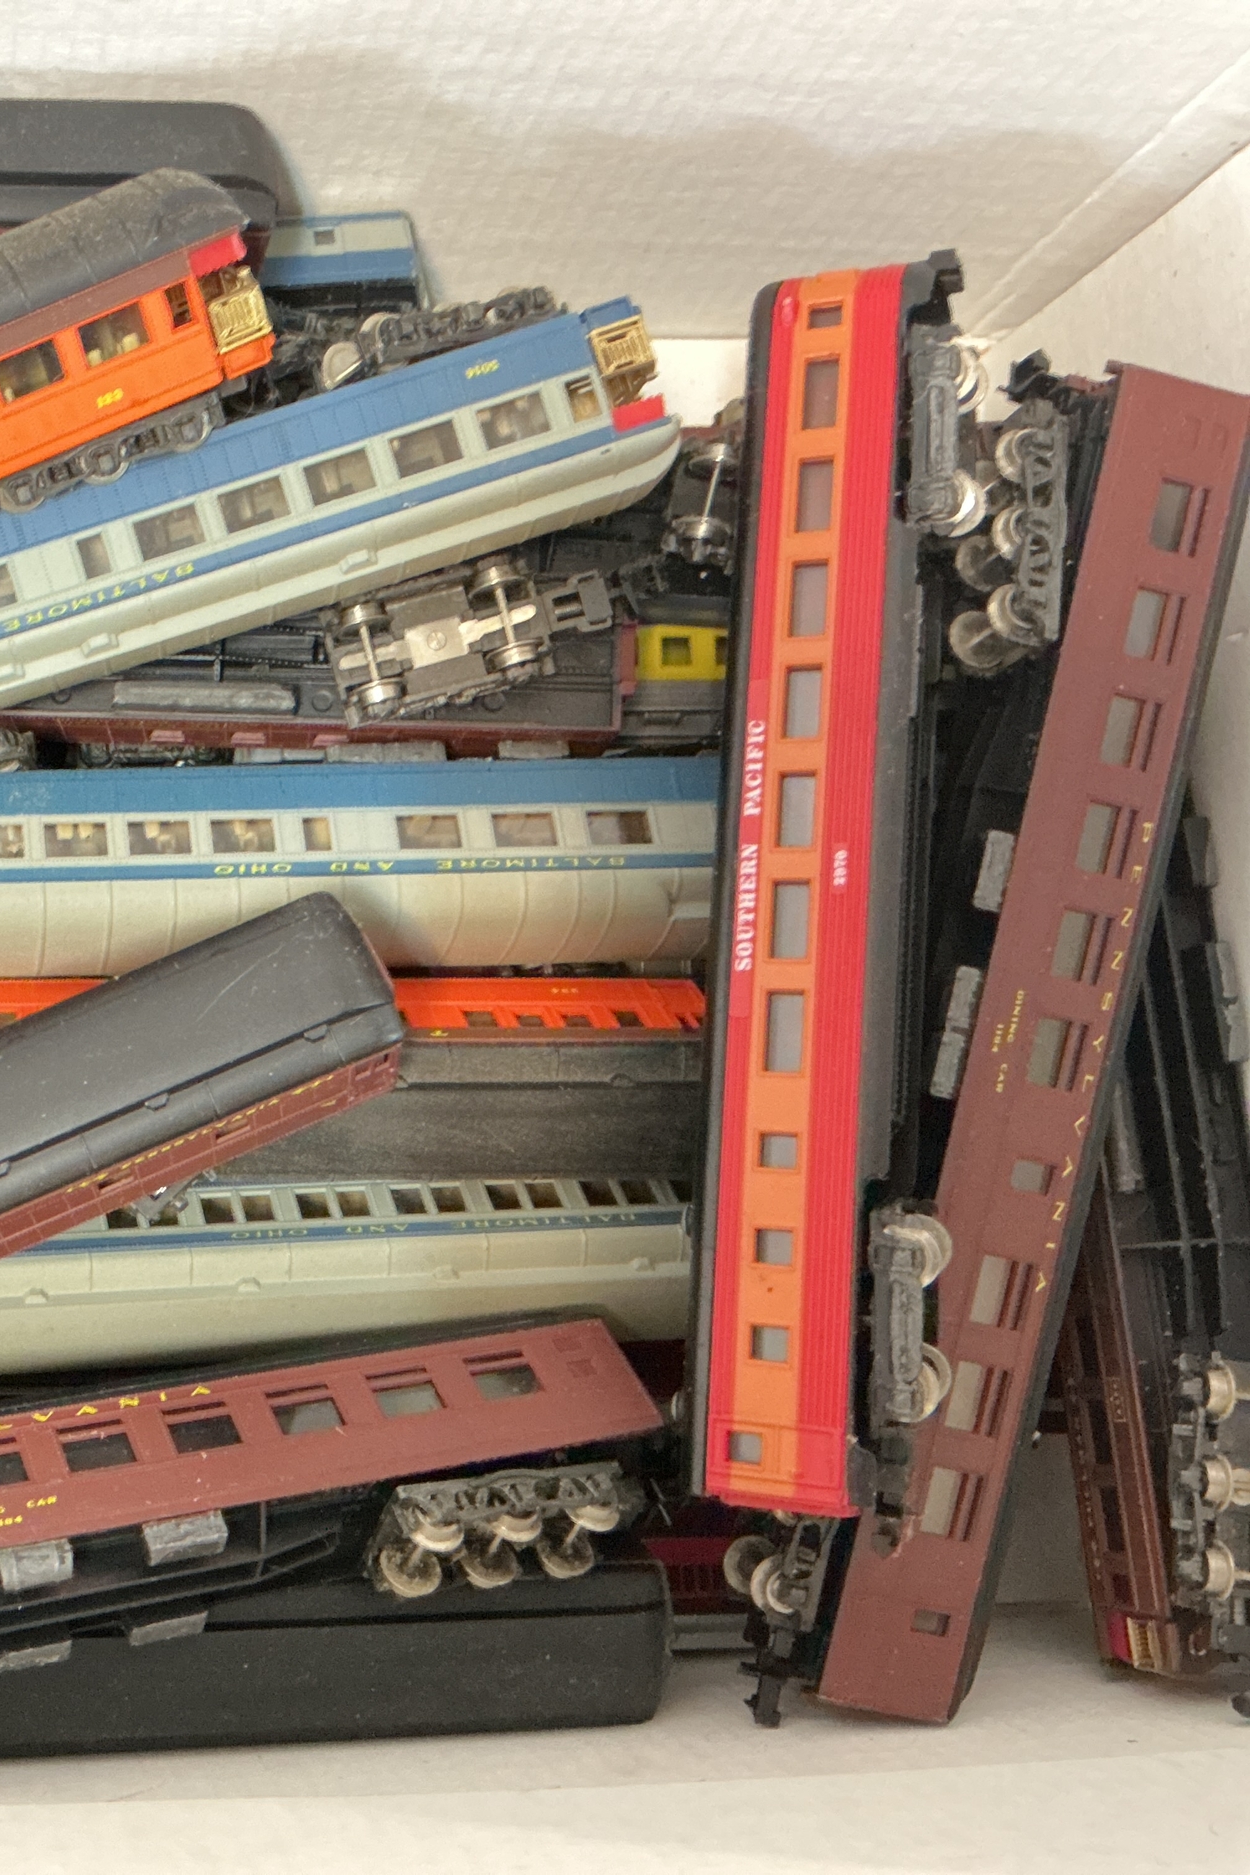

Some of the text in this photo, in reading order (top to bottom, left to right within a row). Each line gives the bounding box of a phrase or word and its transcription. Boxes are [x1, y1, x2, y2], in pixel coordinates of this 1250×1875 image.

[3, 562, 195, 632] BALTIMORE
[213, 856, 626, 876] BALTIMORE AND OHIO
[735, 719, 766, 972] SOUTHERN PACIFIC
[995, 990, 1025, 1093] DINING CAR
[1034, 822, 1155, 1293] PENNSYLVANIA
[231, 1213, 637, 1240] BALTIMORE AND OHIO
[26, 1495, 57, 1508] CAR
